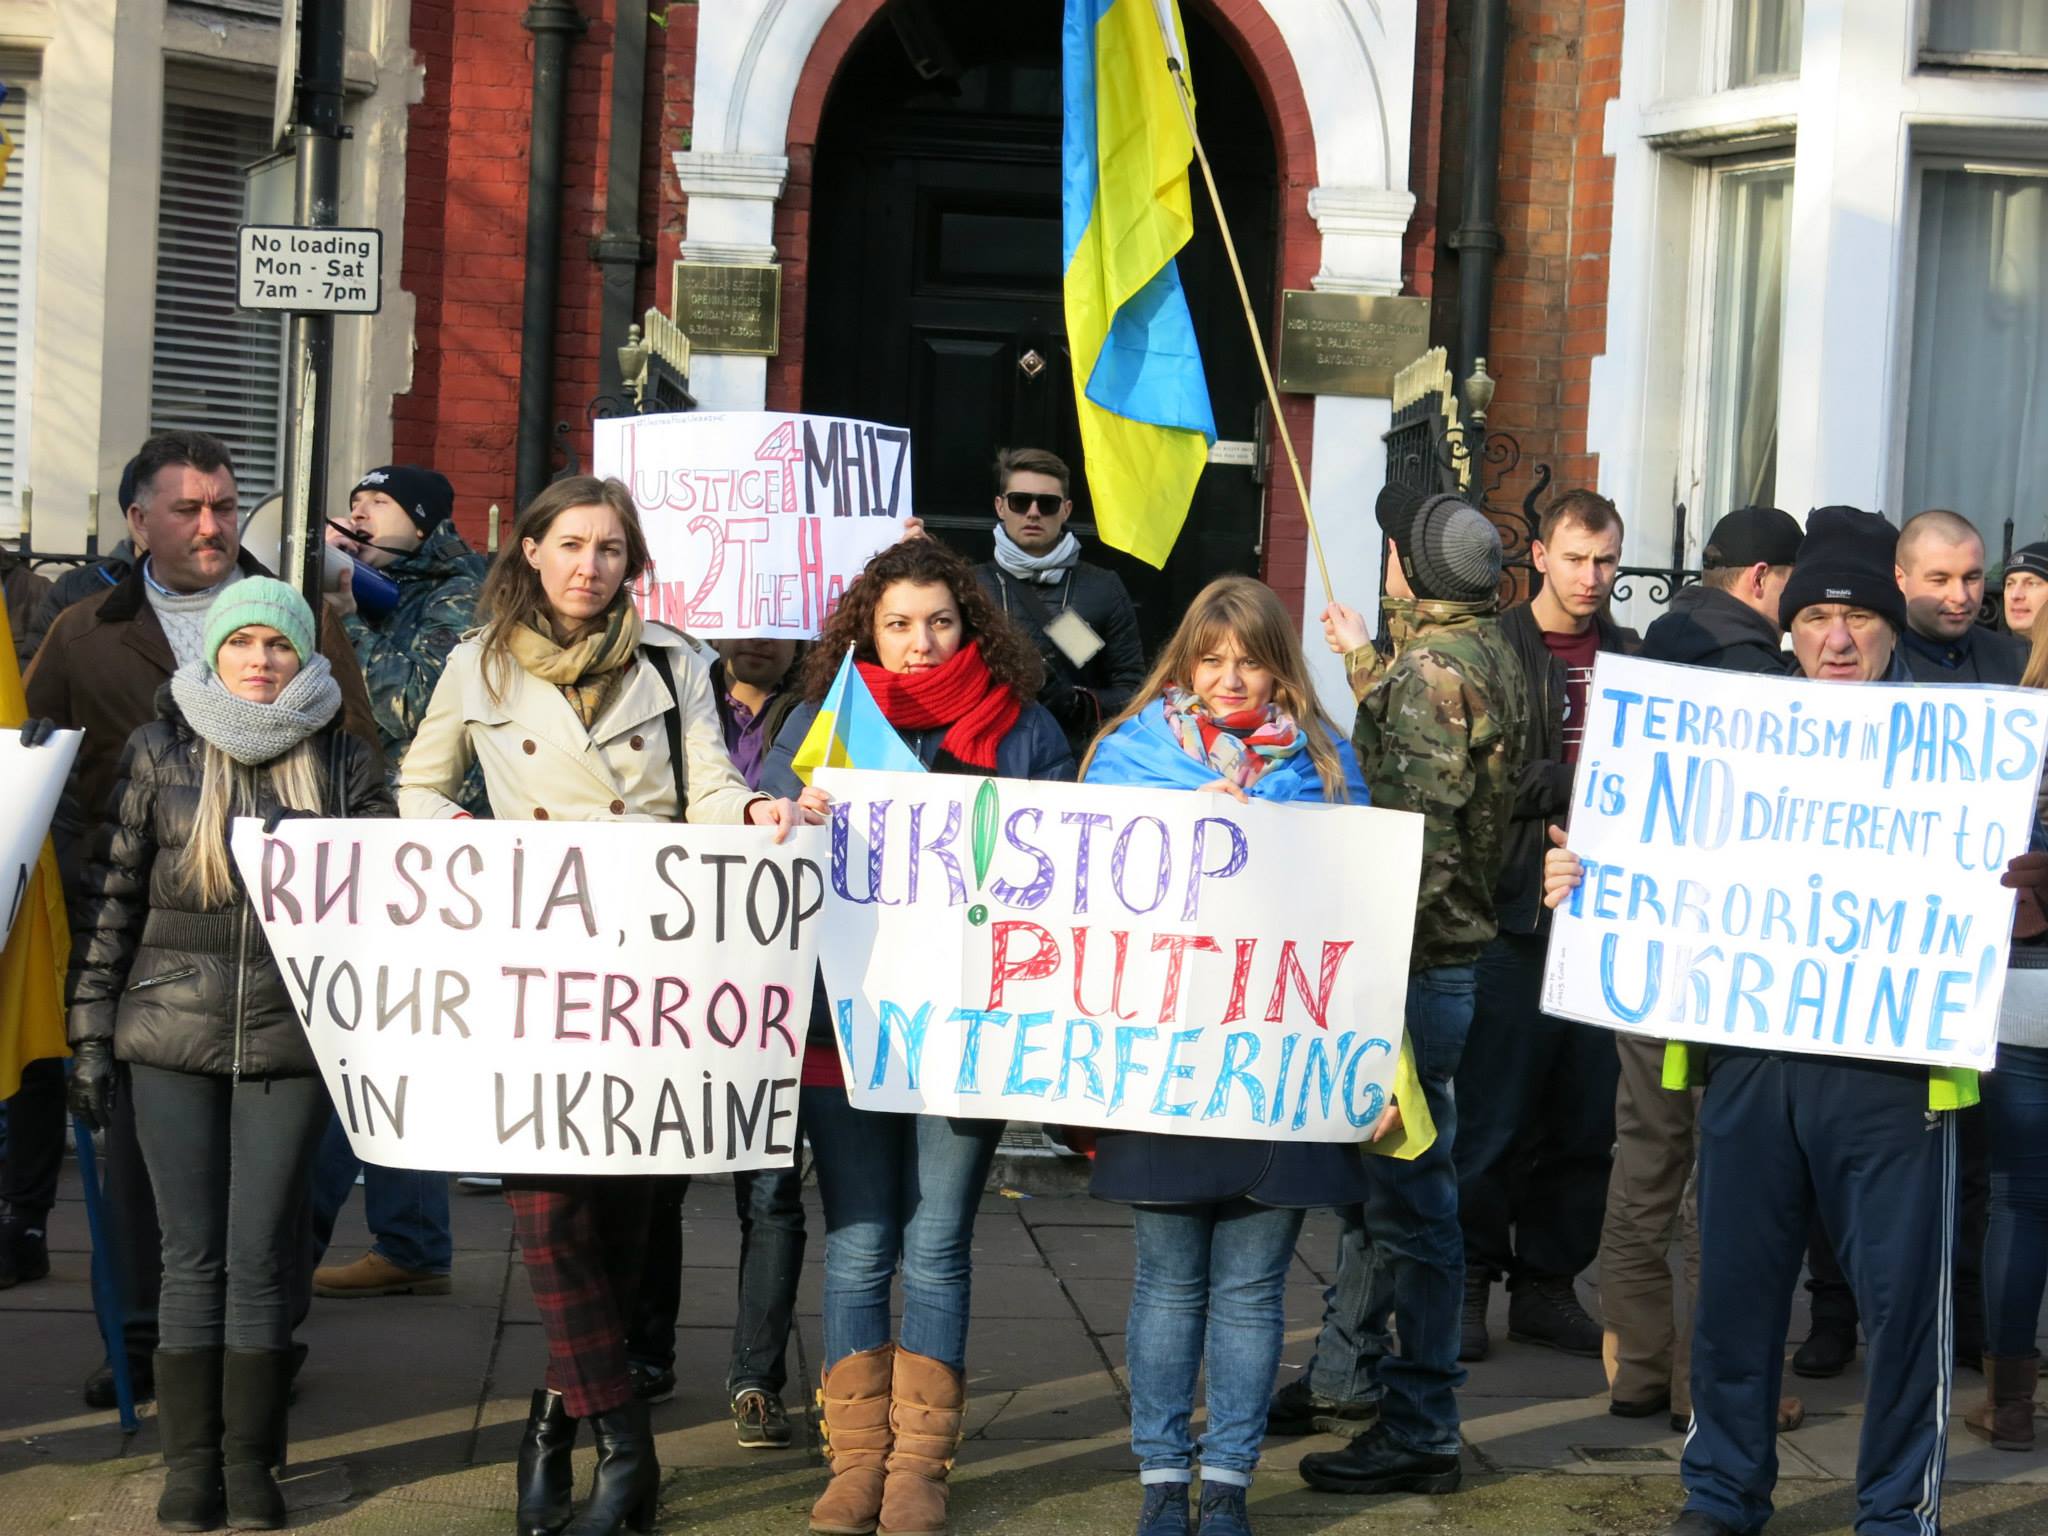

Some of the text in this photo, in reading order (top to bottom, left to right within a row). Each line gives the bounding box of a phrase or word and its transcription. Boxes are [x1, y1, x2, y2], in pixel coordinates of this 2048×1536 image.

[252, 234, 370, 258] No loading
[253, 280, 297, 298] 7am
[321, 282, 366, 302] 7pm
[255, 257, 301, 275] Mon
[327, 259, 364, 277] Sat
[803, 419, 909, 518] MH17
[1639, 752, 1734, 851] NO
[650, 845, 824, 950] STOP
[991, 807, 1248, 922] STOP
[287, 954, 798, 1057] YOUR TERROR
[985, 920, 1354, 1030] PUTIN
